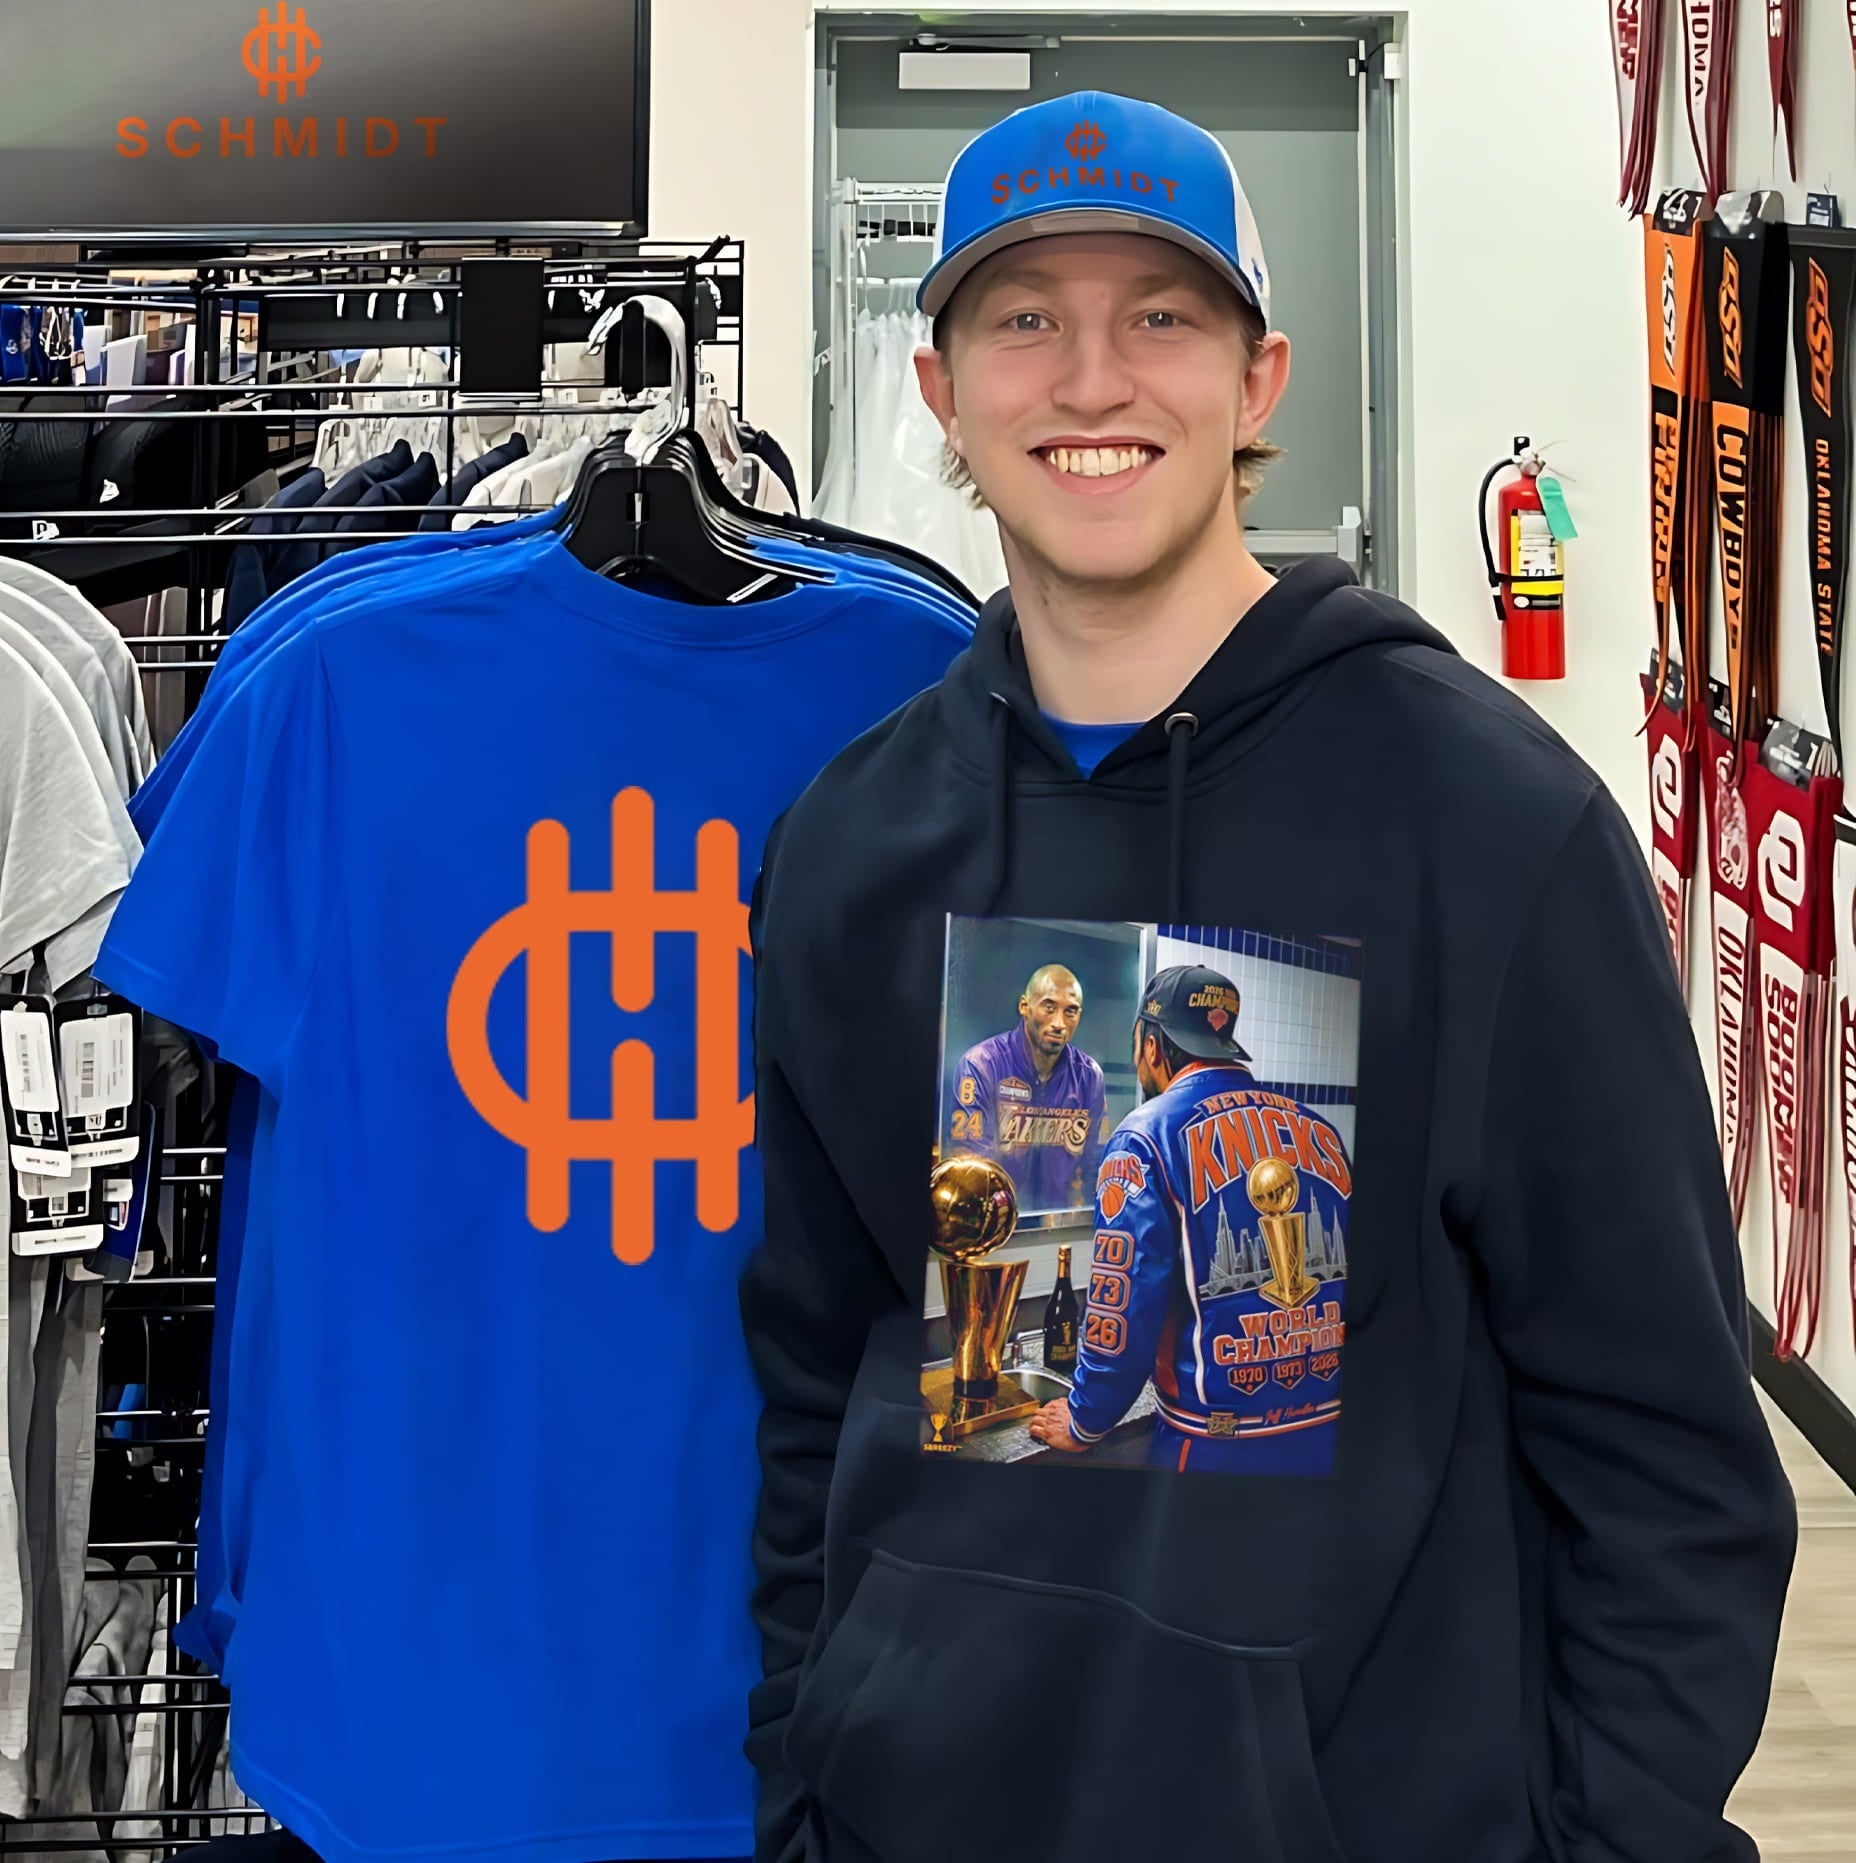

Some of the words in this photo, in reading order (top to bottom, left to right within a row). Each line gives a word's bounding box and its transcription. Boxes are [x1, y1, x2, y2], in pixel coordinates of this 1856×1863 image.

[116, 116, 447, 159] SCHMIDT
[991, 166, 1180, 205] SCHMIDT
[1815, 438, 1832, 570] OKLAHOMA
[1817, 582, 1834, 657] STATE
[1719, 926, 1745, 1143] OKLAHOMA
[959, 1076, 976, 1105] 8
[1203, 1091, 1248, 1115] NEW
[1249, 1091, 1300, 1113] YORK
[950, 1109, 983, 1141] 24
[1186, 1106, 1352, 1213] KNICKS
[1094, 1235, 1125, 1265] 70
[1091, 1275, 1120, 1305] 73
[1085, 1313, 1118, 1347] 26
[1239, 1301, 1341, 1340] WORLD
[1213, 1322, 1346, 1366] CHAMPION
[1231, 1365, 1264, 1384] 1970
[1275, 1360, 1303, 1379] 1973
